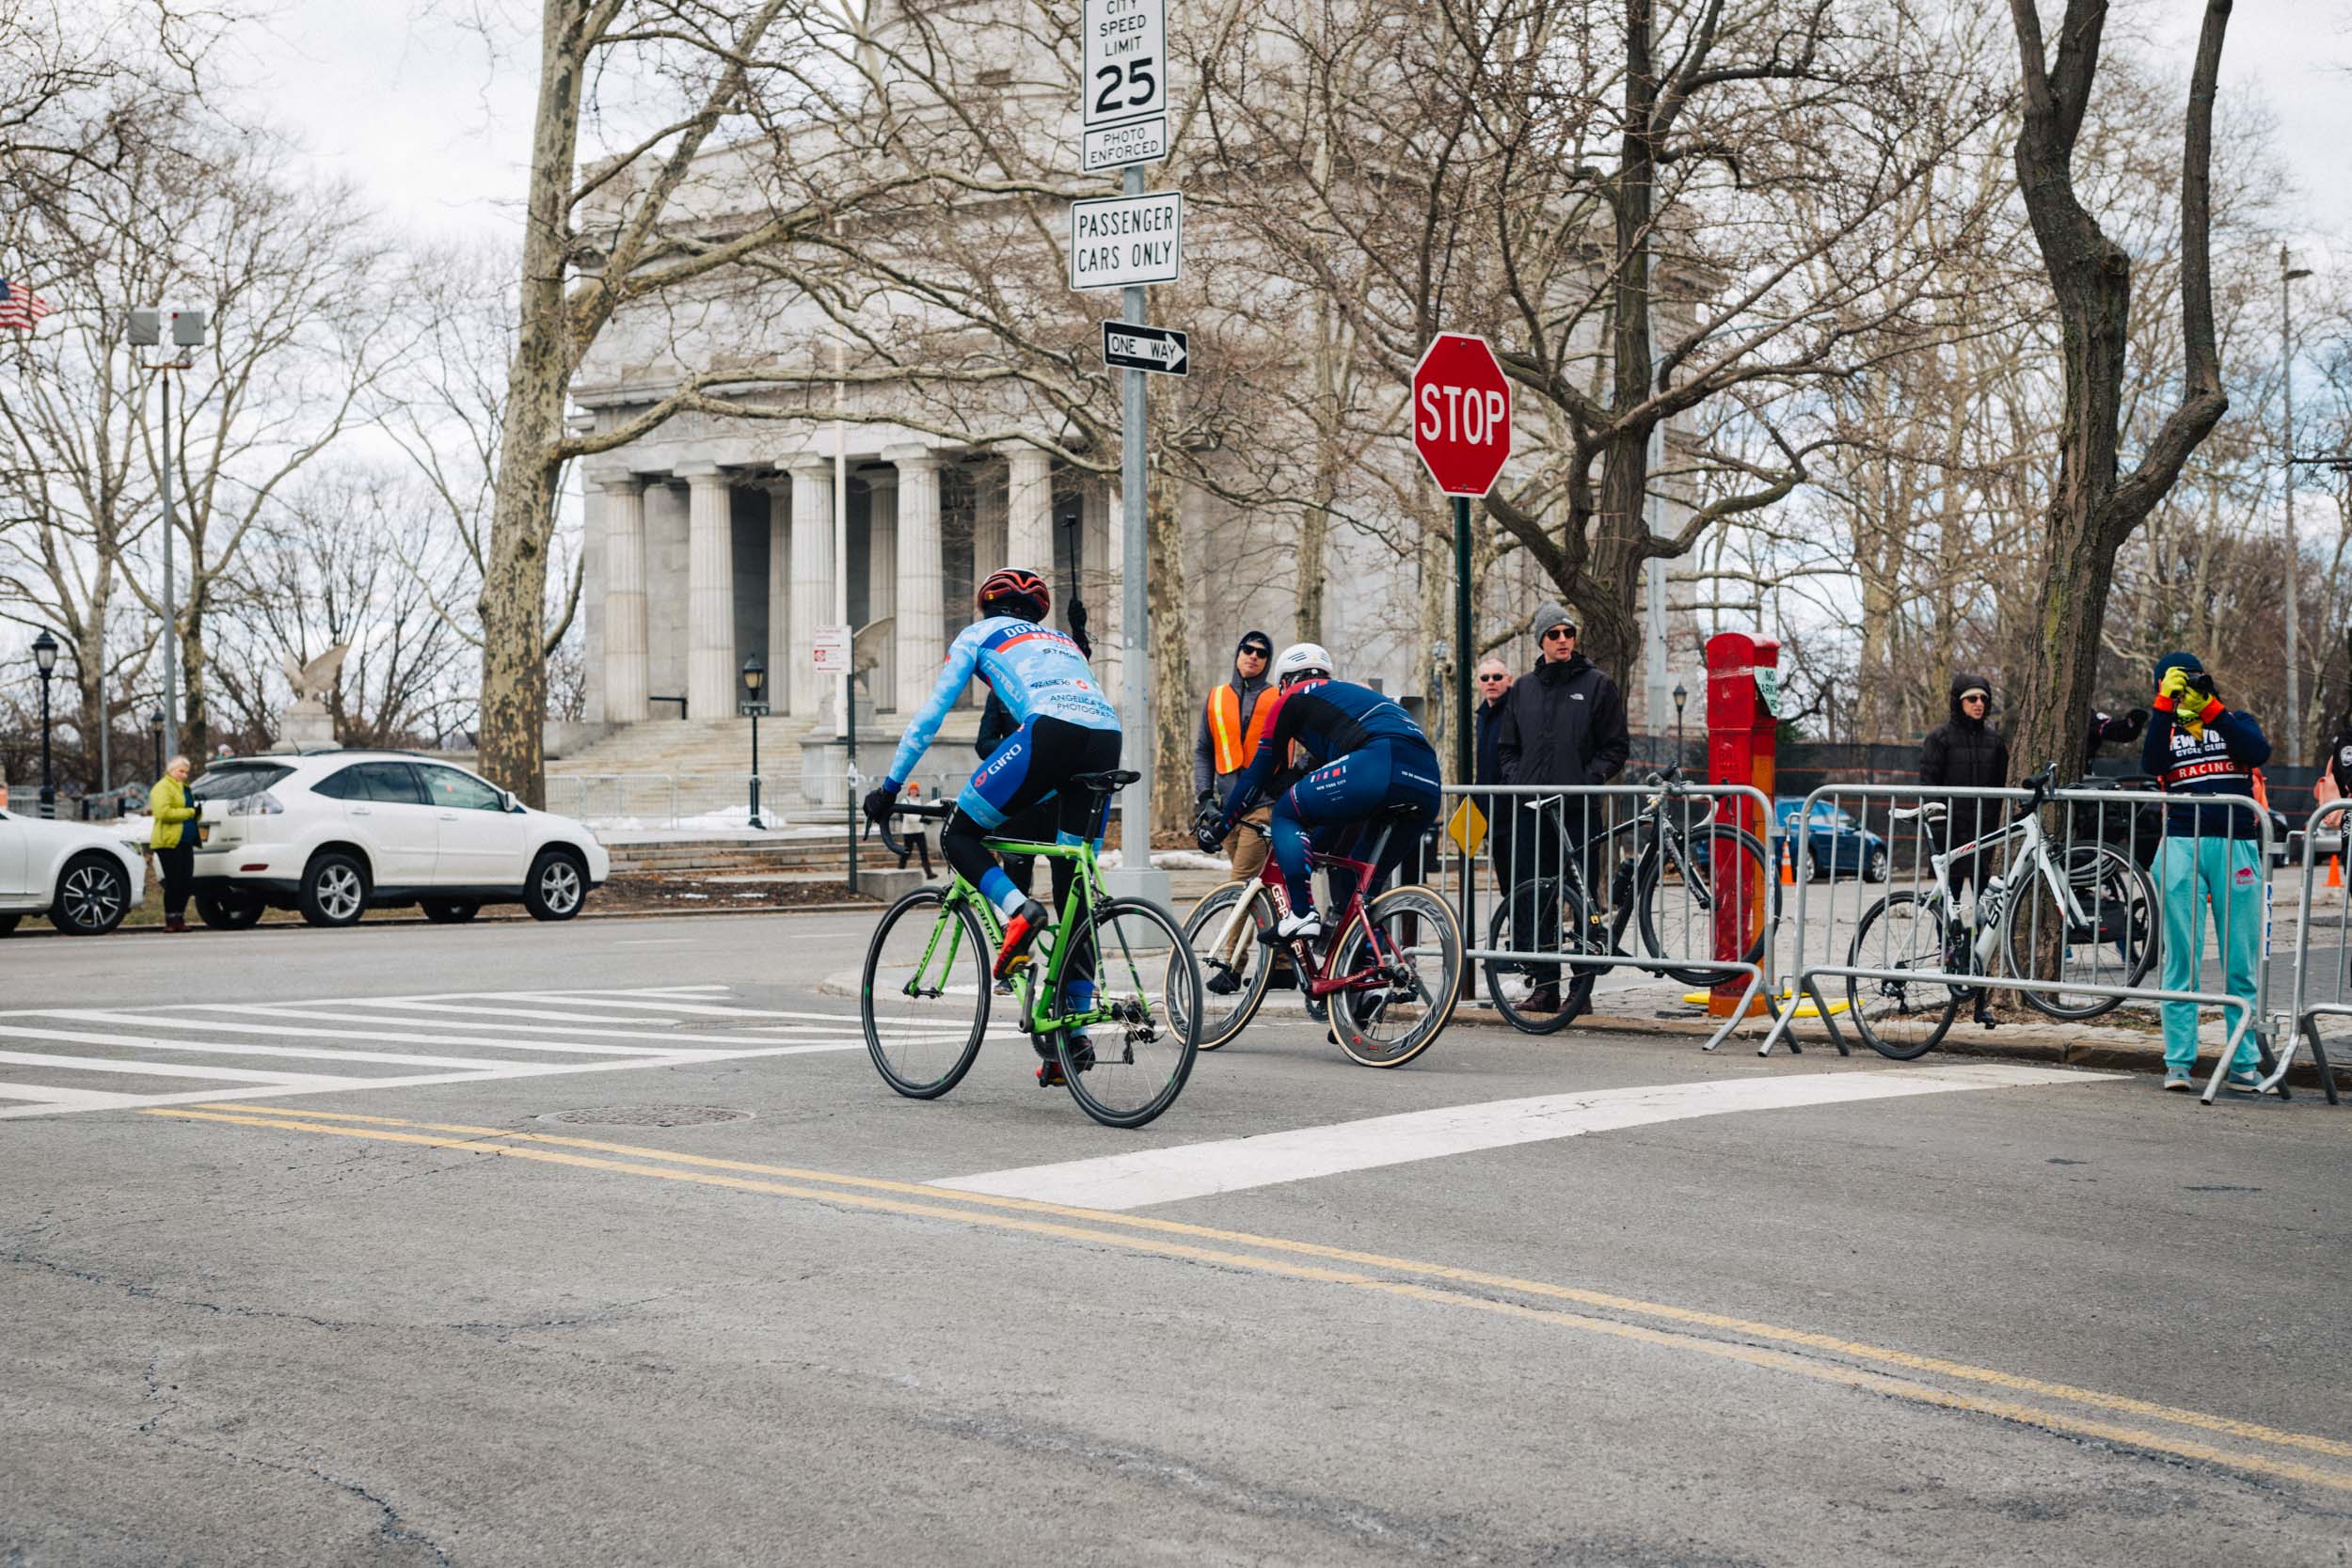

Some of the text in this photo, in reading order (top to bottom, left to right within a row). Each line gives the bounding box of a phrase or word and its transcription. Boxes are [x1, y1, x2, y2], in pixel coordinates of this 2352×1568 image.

[1106, 0, 1137, 15] CITY
[1099, 14, 1147, 37] SPEED
[1104, 36, 1142, 56] LIMIT
[1095, 56, 1155, 113] 25
[1104, 127, 1146, 146] PHOTO
[1090, 140, 1159, 165] ENFORCED
[1079, 206, 1173, 239] PASSENGER
[1078, 240, 1172, 273] CARS ONLY
[1111, 336, 1176, 359] ONE WAY
[1421, 383, 1505, 446] STOP
[988, 743, 1023, 775] GIRO
[2175, 742, 2227, 757] CYCLE CLUB
[2179, 761, 2234, 778] RACING
